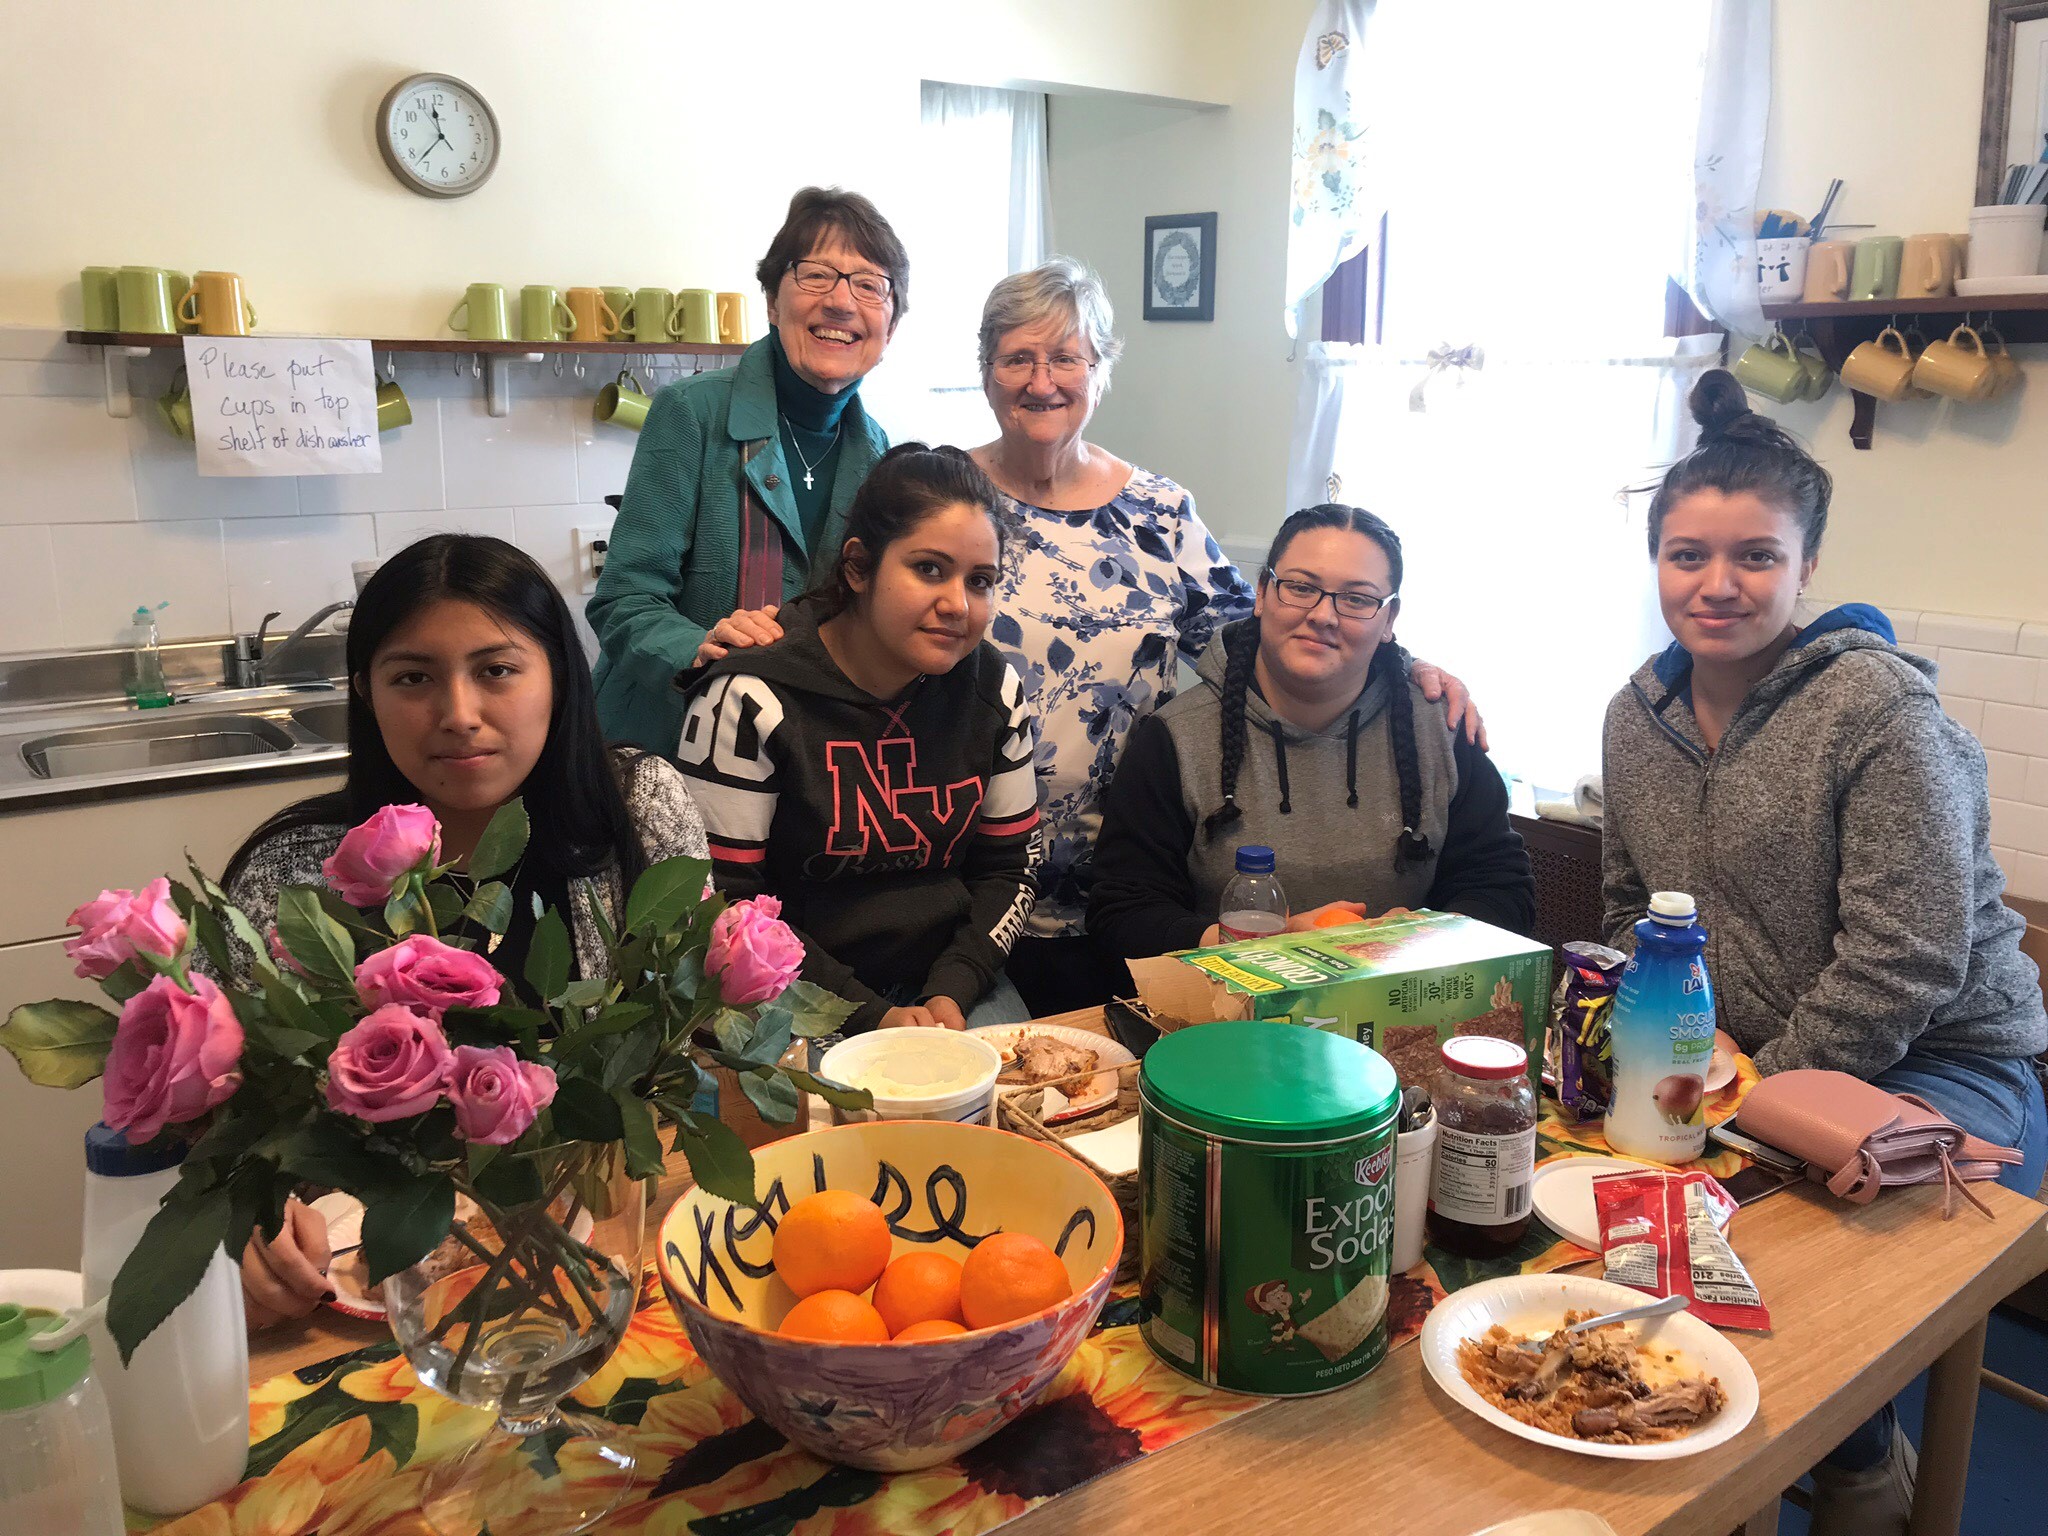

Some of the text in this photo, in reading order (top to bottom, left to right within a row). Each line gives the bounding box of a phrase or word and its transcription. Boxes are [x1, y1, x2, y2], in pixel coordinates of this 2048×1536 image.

[415, 98, 427, 110] 11
[432, 94, 444, 106] 12
[454, 100, 459, 112] 1
[405, 110, 417, 122] 10
[467, 114, 475, 127] 2
[400, 128, 408, 140] 9
[474, 132, 482, 144] 3
[407, 147, 416, 159] 8
[470, 150, 478, 162] 4
[422, 160, 430, 172] 7
[440, 166, 449, 178] 6
[458, 162, 466, 174] 5
[198, 346, 334, 390] Please put
[290, 396, 307, 413] in
[315, 387, 350, 420] top
[218, 425, 267, 451] shelf
[273, 427, 289, 449] of
[825, 736, 985, 870] NY
[1231, 949, 1329, 984] CRUNCHY
[1427, 981, 1441, 1002] 30%
[1445, 977, 1453, 1001] WHOLE
[1452, 975, 1460, 1000] GRAINS
[1388, 988, 1402, 1007] NO
[1401, 978, 1409, 1013] ARTIFICIAL
[1675, 1043, 1689, 1053] 6g
[1442, 1129, 1474, 1145] Nutrition
[1475, 1138, 1498, 1147] Facts
[1659, 1133, 1696, 1142] TROPICAL
[1440, 1150, 1467, 1165] Calories
[1484, 1159, 1497, 1167] 50
[1356, 1150, 1392, 1183] Keebler
[1305, 1173, 1396, 1236] Expor
[1692, 1271, 1714, 1280] 210
[1719, 1295, 1760, 1306] Nutrition
[1315, 1367, 1334, 1379] PESO
[1334, 1362, 1351, 1374] NETO
